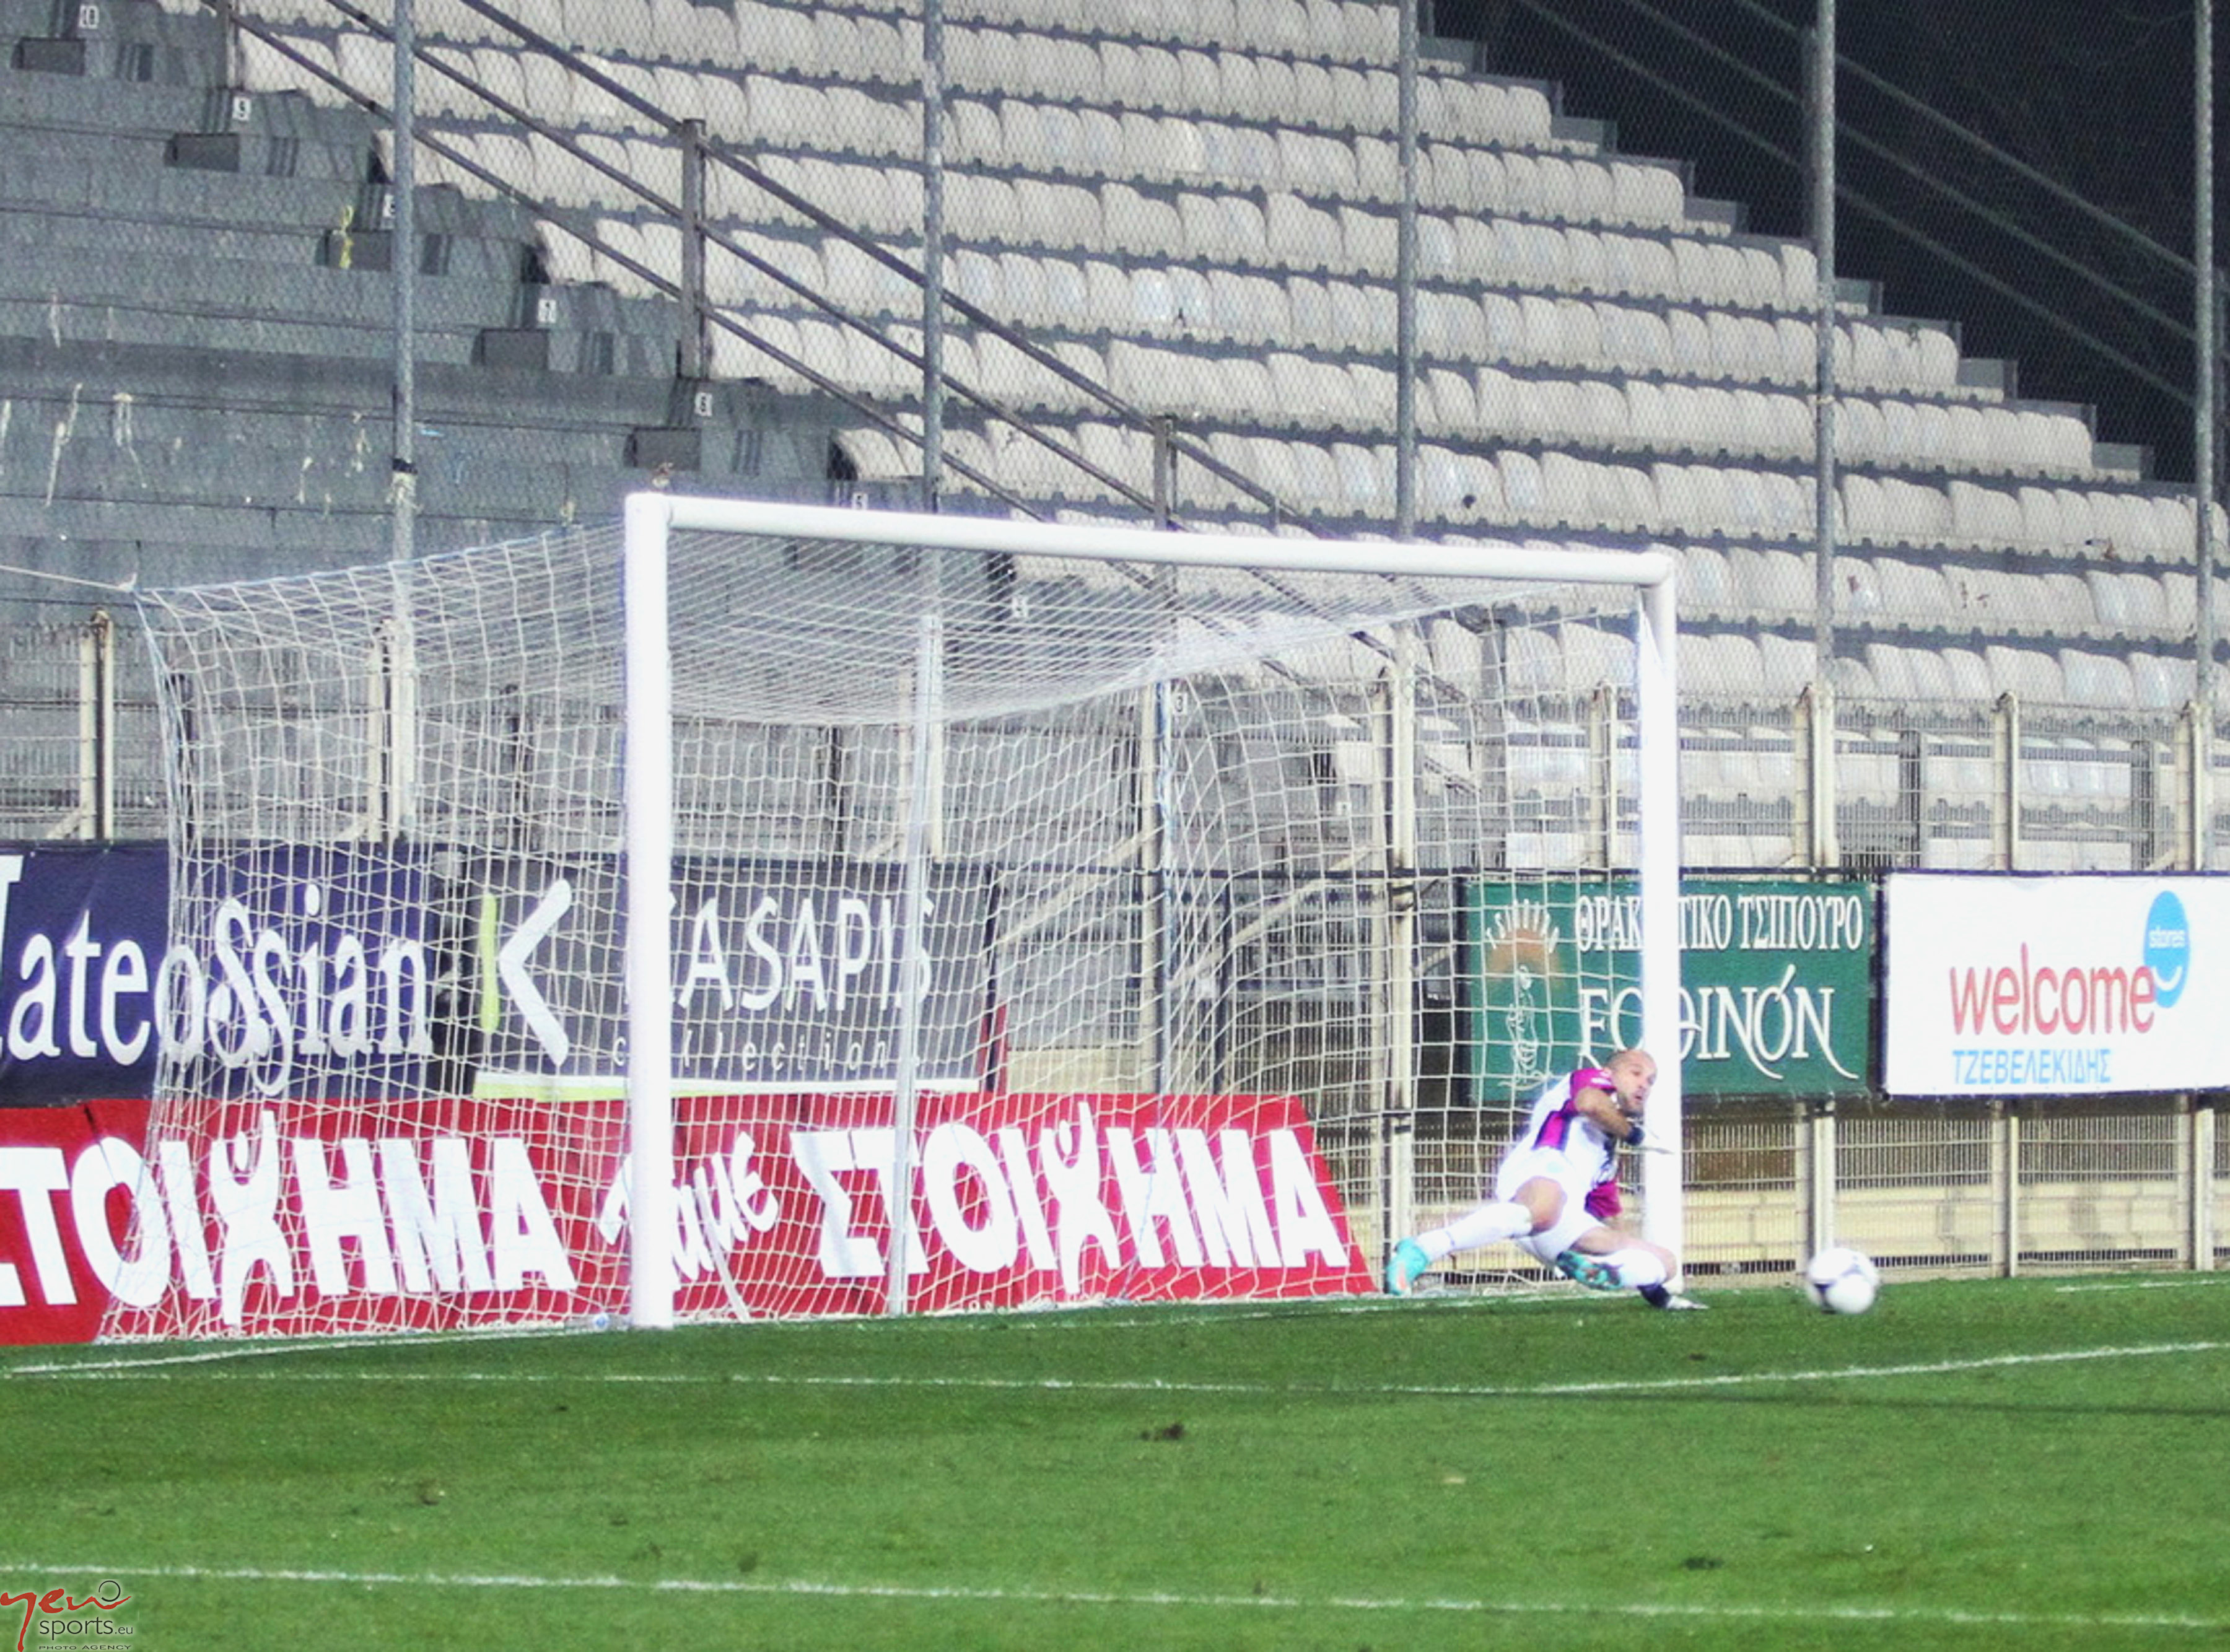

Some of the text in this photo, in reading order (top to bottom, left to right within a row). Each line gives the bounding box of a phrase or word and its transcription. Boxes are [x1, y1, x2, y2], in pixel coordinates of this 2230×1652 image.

[623, 892, 934, 1012] ASAPIS
[1575, 895, 1863, 950] ΘΡΑΚΤΙΚΟ ΤΣΙΠΟΥΡΟ
[1949, 942, 2155, 1036] welcome
[612, 1028, 921, 1072] cllection
[1952, 1048, 2112, 1085] ΤΖΕΒΕΛΕΚΙΔΗΣ
[790, 1101, 1350, 1295] ΣΤΟΙΧΗΜΑ
